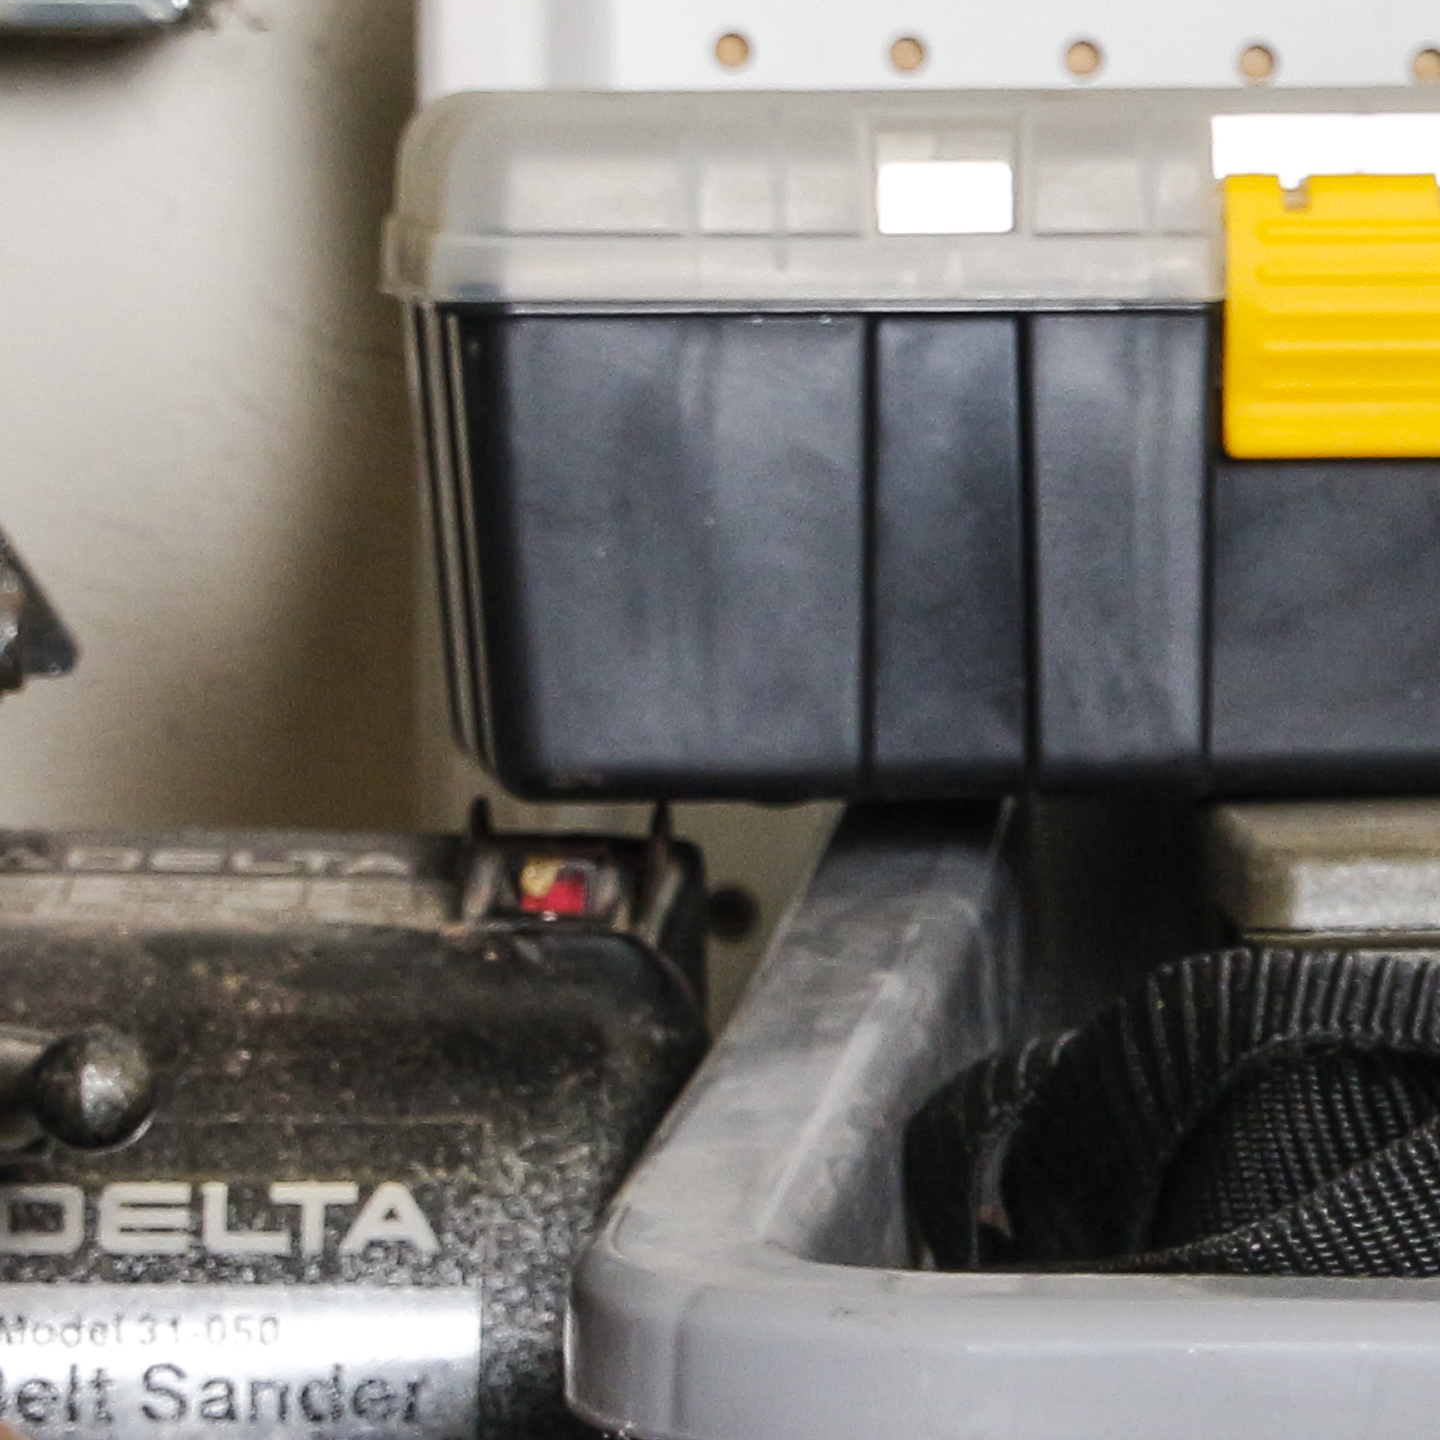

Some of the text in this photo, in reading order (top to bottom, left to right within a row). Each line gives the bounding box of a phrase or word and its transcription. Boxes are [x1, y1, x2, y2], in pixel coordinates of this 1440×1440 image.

[0, 1181, 442, 1258] DELTA
[0, 1312, 124, 1348] Model
[0, 1362, 427, 1424] elt Sander
